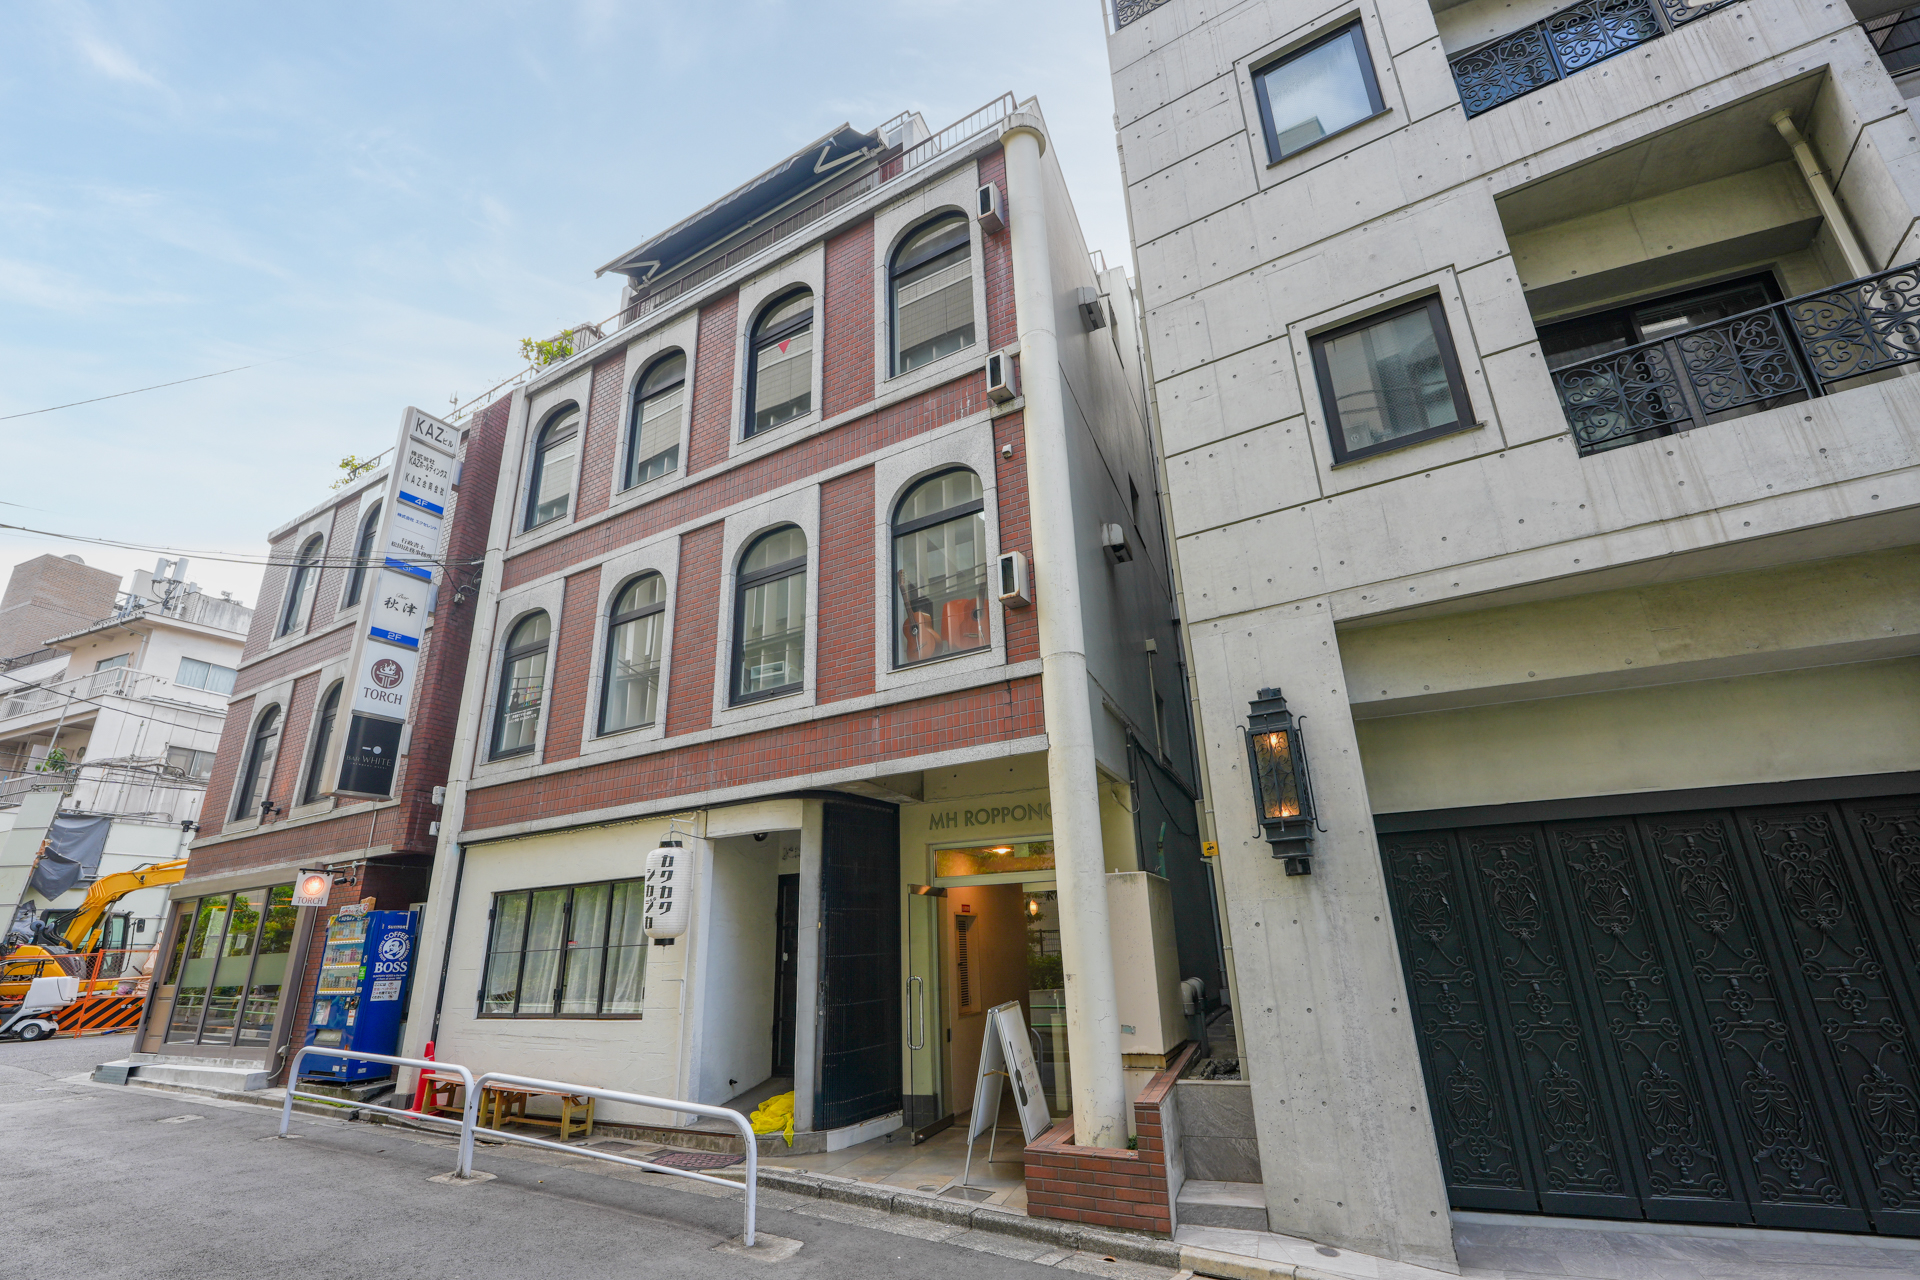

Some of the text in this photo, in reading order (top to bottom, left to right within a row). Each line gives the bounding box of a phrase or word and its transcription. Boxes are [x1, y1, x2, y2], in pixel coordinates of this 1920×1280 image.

[415, 498, 428, 506] 4F
[401, 537, 426, 551] 行政書士
[384, 597, 418, 616] 秋津
[387, 631, 402, 640] 2F
[364, 687, 403, 705] TORCH
[362, 755, 393, 767] WHITE
[929, 811, 958, 830] MH
[659, 855, 675, 915] カクカク
[297, 896, 324, 905] TORCH
[384, 931, 409, 941] COFFEE
[373, 961, 408, 973] BOSS
